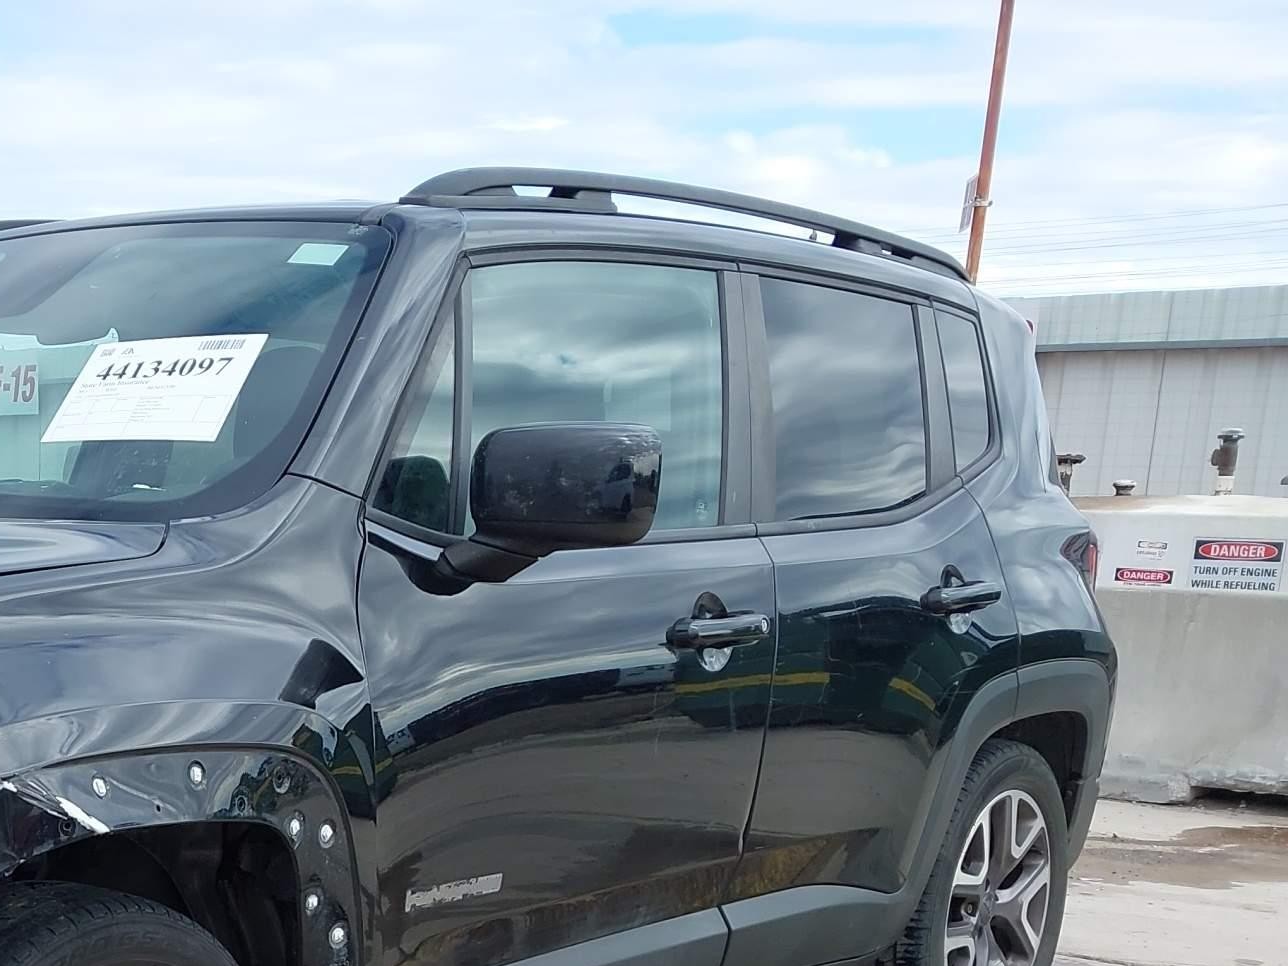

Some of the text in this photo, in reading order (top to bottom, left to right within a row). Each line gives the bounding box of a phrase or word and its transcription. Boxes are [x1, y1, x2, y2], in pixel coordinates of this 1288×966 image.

[96, 356, 235, 381] 44134097
[1210, 544, 1266, 558] DANGER
[1123, 570, 1164, 581] DANGER
[1193, 565, 1278, 577] TURN OFF ENGINE
[1191, 579, 1276, 592] WHILE REFUELING
